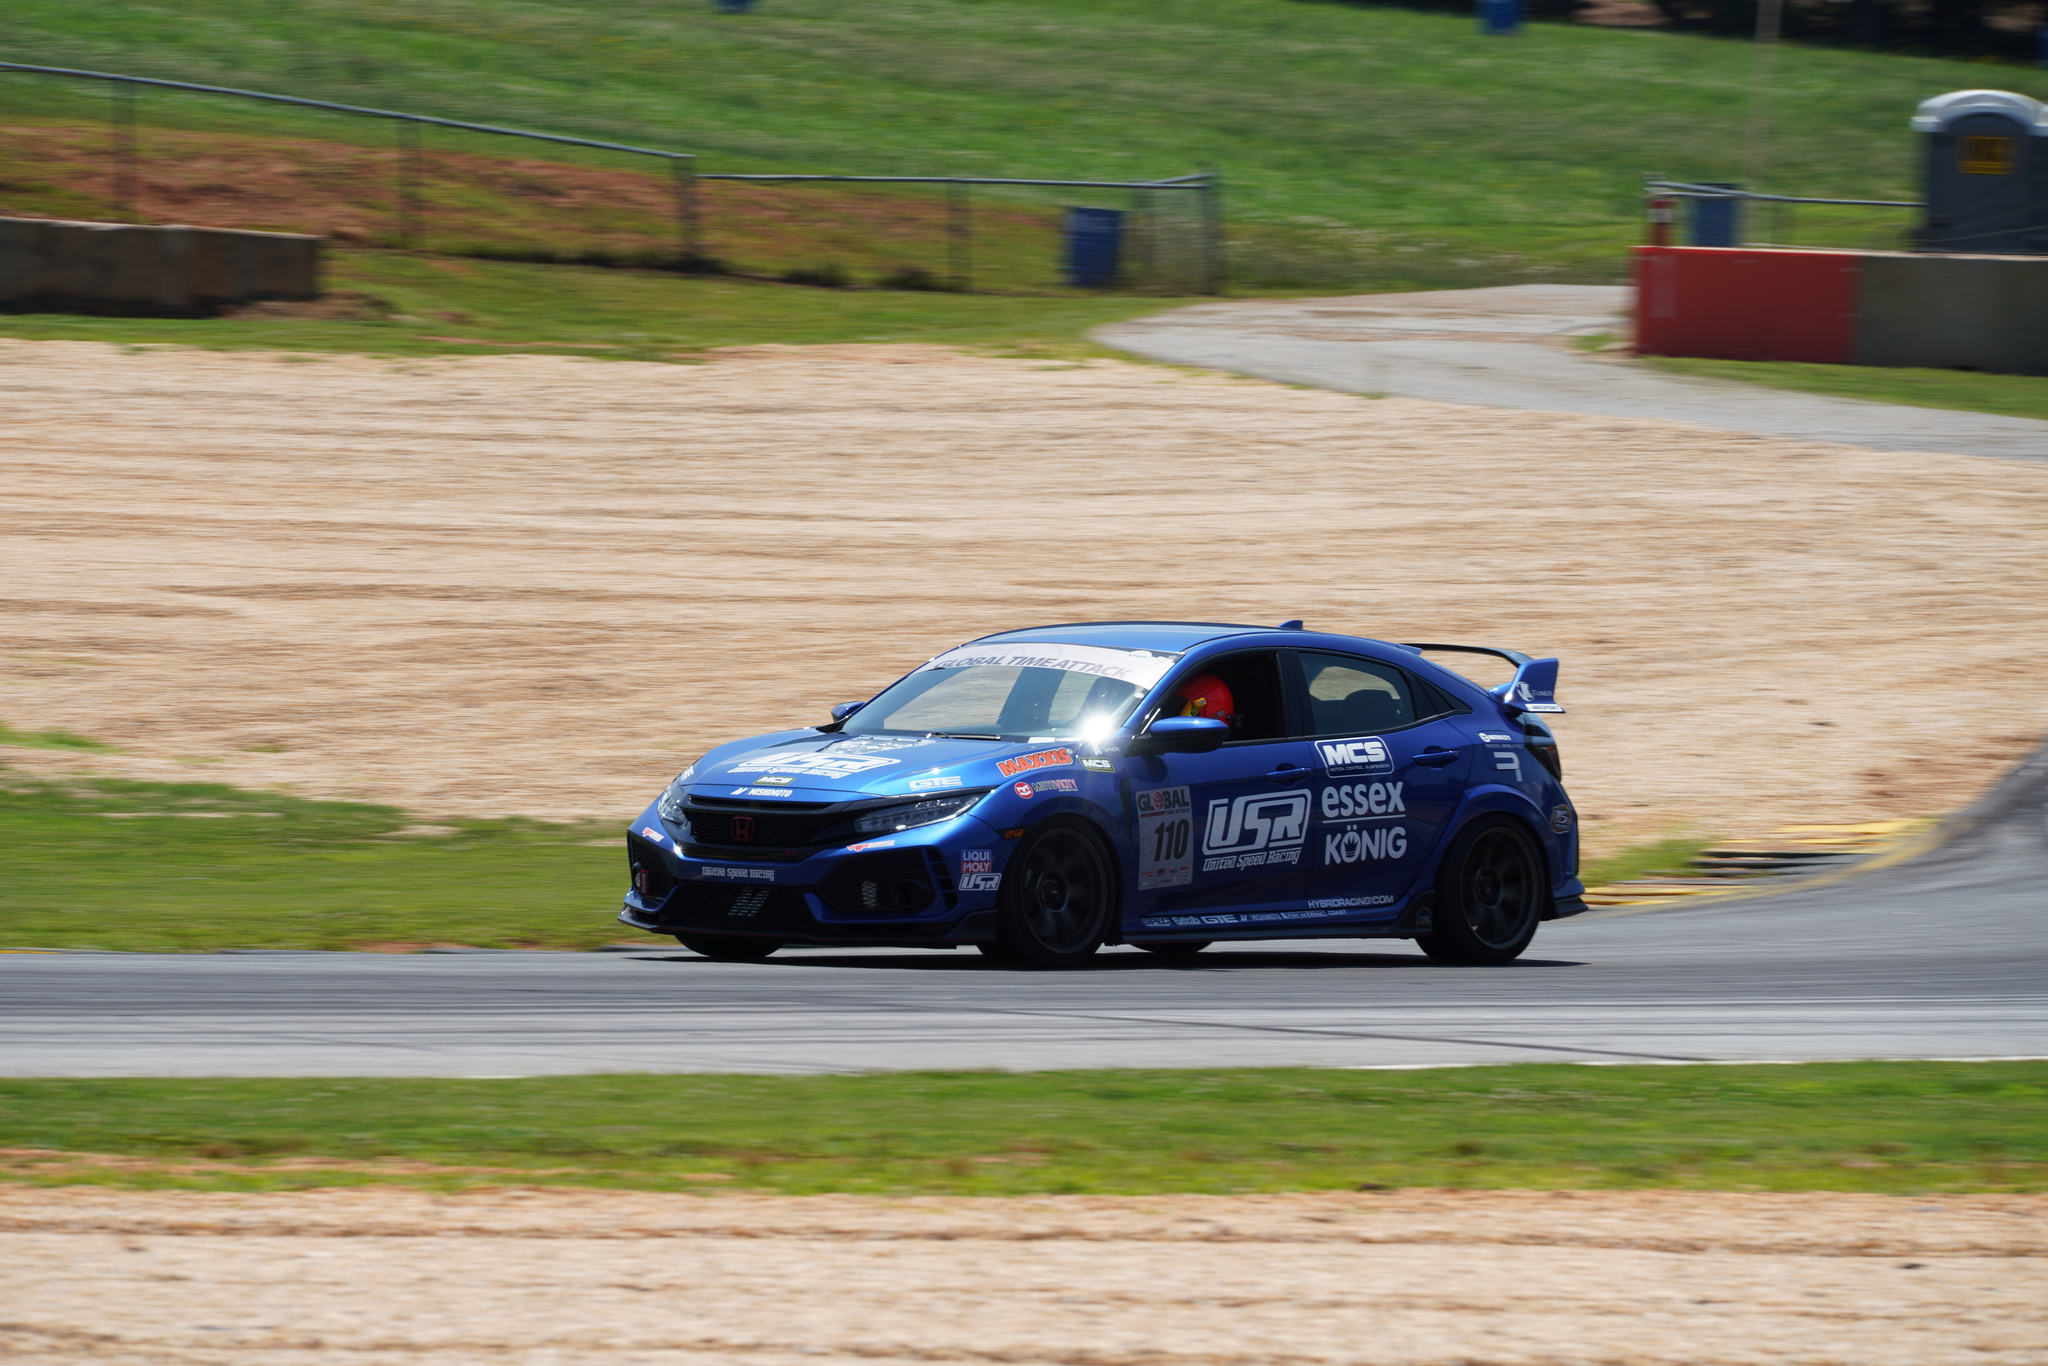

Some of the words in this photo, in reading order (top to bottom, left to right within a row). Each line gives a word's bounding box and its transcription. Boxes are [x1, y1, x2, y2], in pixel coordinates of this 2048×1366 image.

[996, 747, 1073, 777] MAXXIS
[1081, 759, 1111, 768] MCS
[1323, 741, 1386, 765] MCS
[1137, 789, 1190, 812] GLOBAL
[1321, 781, 1406, 818] essex
[1202, 788, 1312, 856] USR
[1153, 818, 1190, 862] 110
[1324, 824, 1408, 866] KÖNIG
[962, 851, 991, 861] LIQUI
[962, 862, 991, 872] MOLY
[1202, 856, 1237, 872] United
[1236, 851, 1267, 871] Speed
[1266, 847, 1302, 865] Racing
[959, 873, 1002, 891] USR
